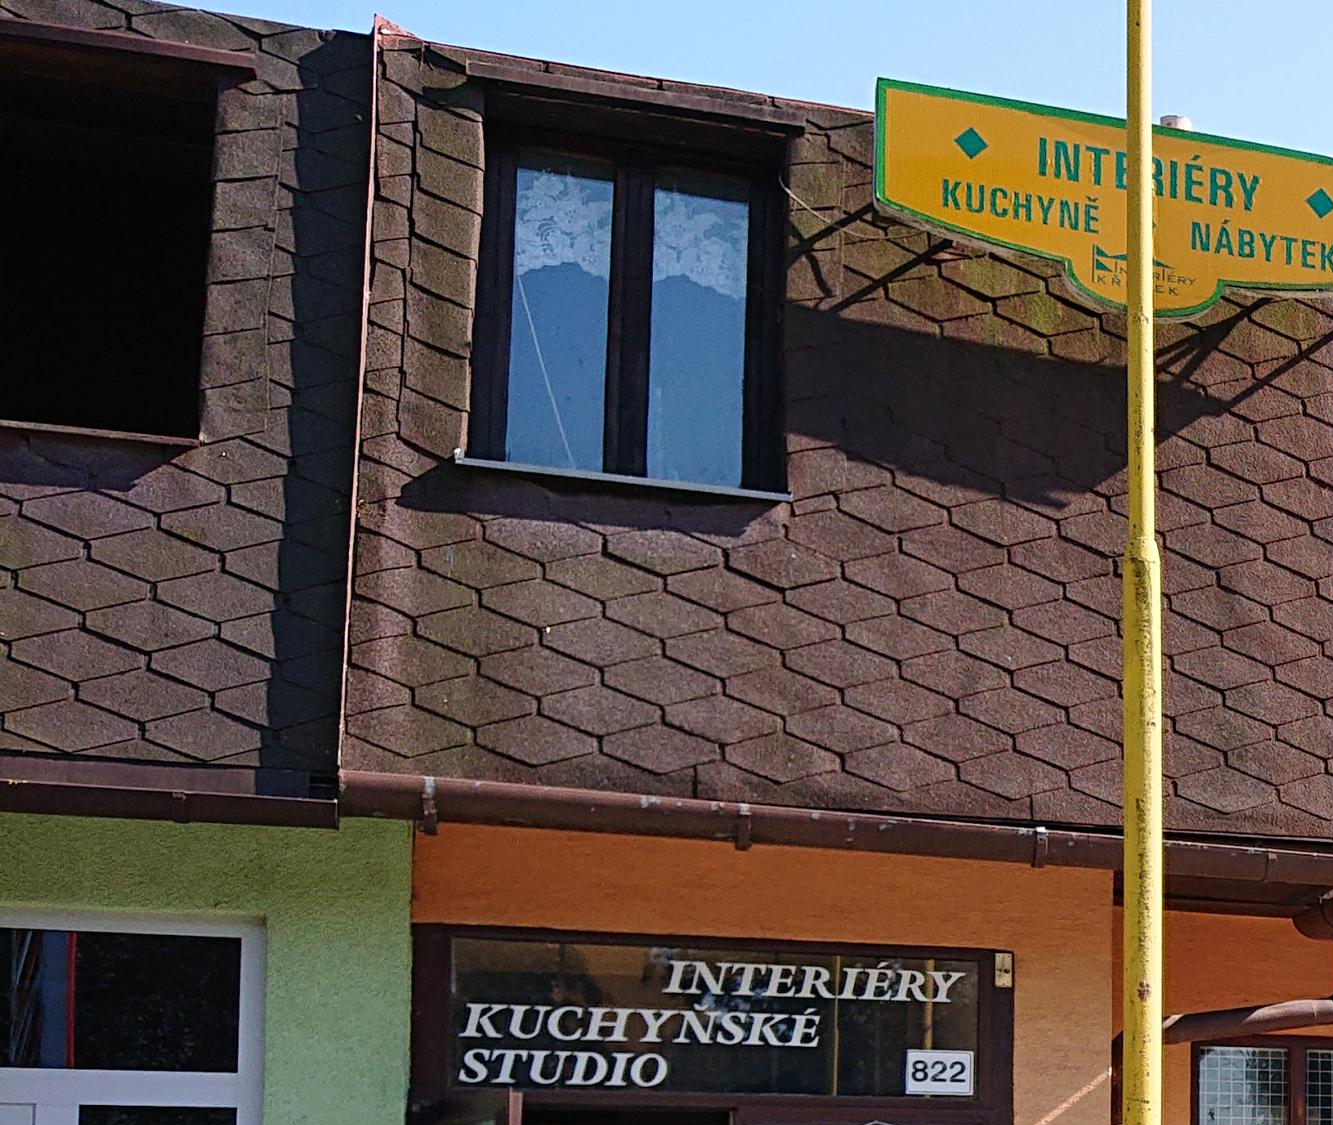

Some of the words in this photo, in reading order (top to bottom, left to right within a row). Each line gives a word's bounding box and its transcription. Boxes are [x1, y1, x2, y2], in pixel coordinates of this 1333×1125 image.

[941, 178, 1099, 234] KUCHYNĚ
[662, 960, 967, 1003] INTERIÉRY
[458, 1002, 821, 1048] KUCHYŇSKÉ
[458, 1049, 668, 1088] STUDIO
[911, 1059, 967, 1084] 822
